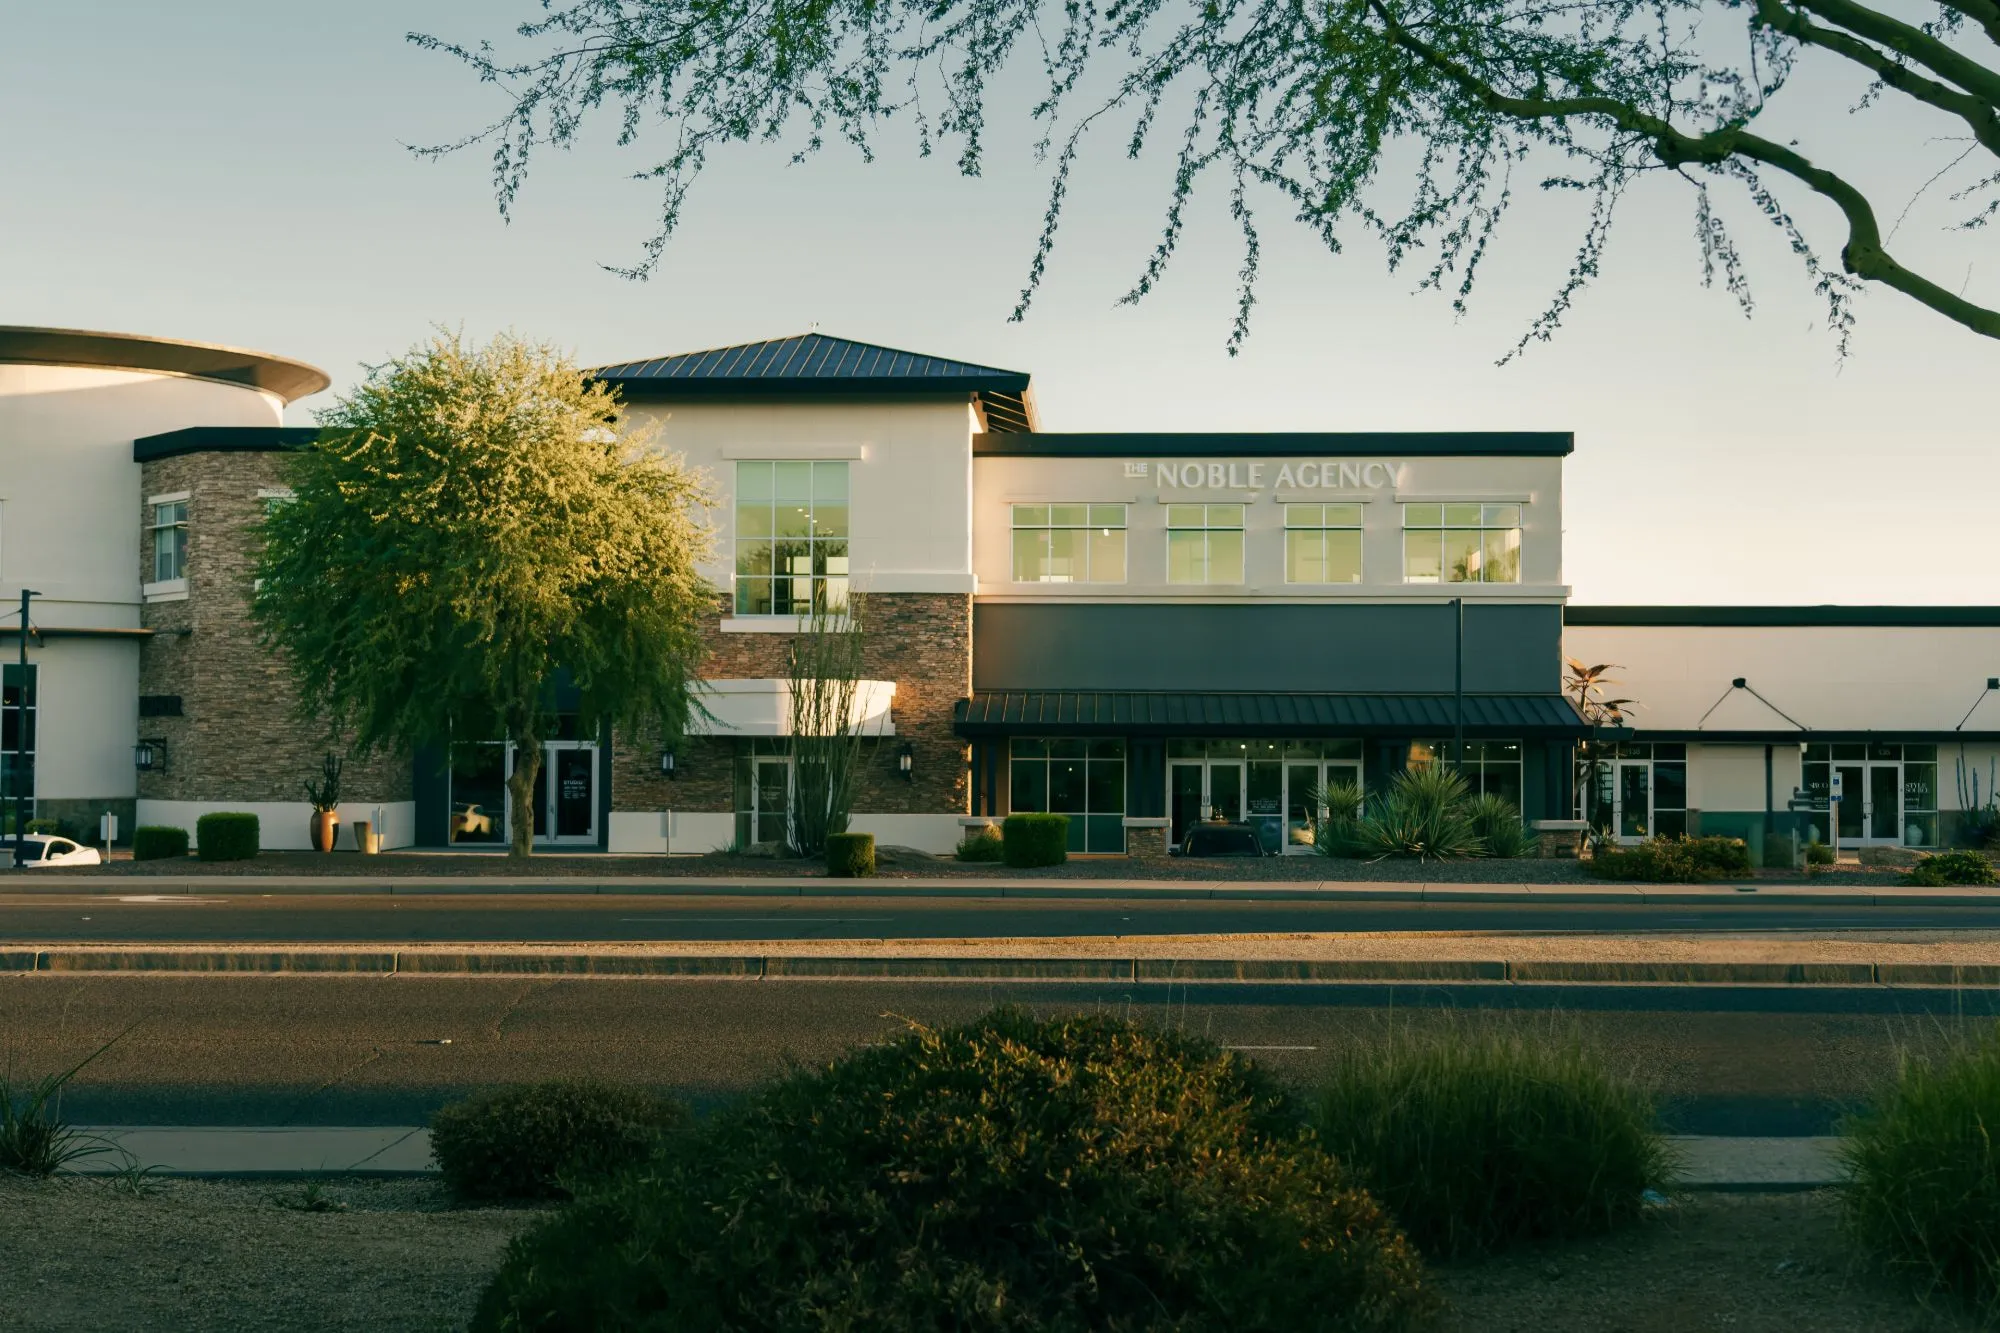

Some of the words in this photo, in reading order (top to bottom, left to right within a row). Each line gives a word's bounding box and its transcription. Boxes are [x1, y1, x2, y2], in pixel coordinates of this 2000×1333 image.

[1123, 462, 1148, 474] THE
[1156, 463, 1265, 488] NOBLE
[1274, 463, 1408, 488] AGENCY
